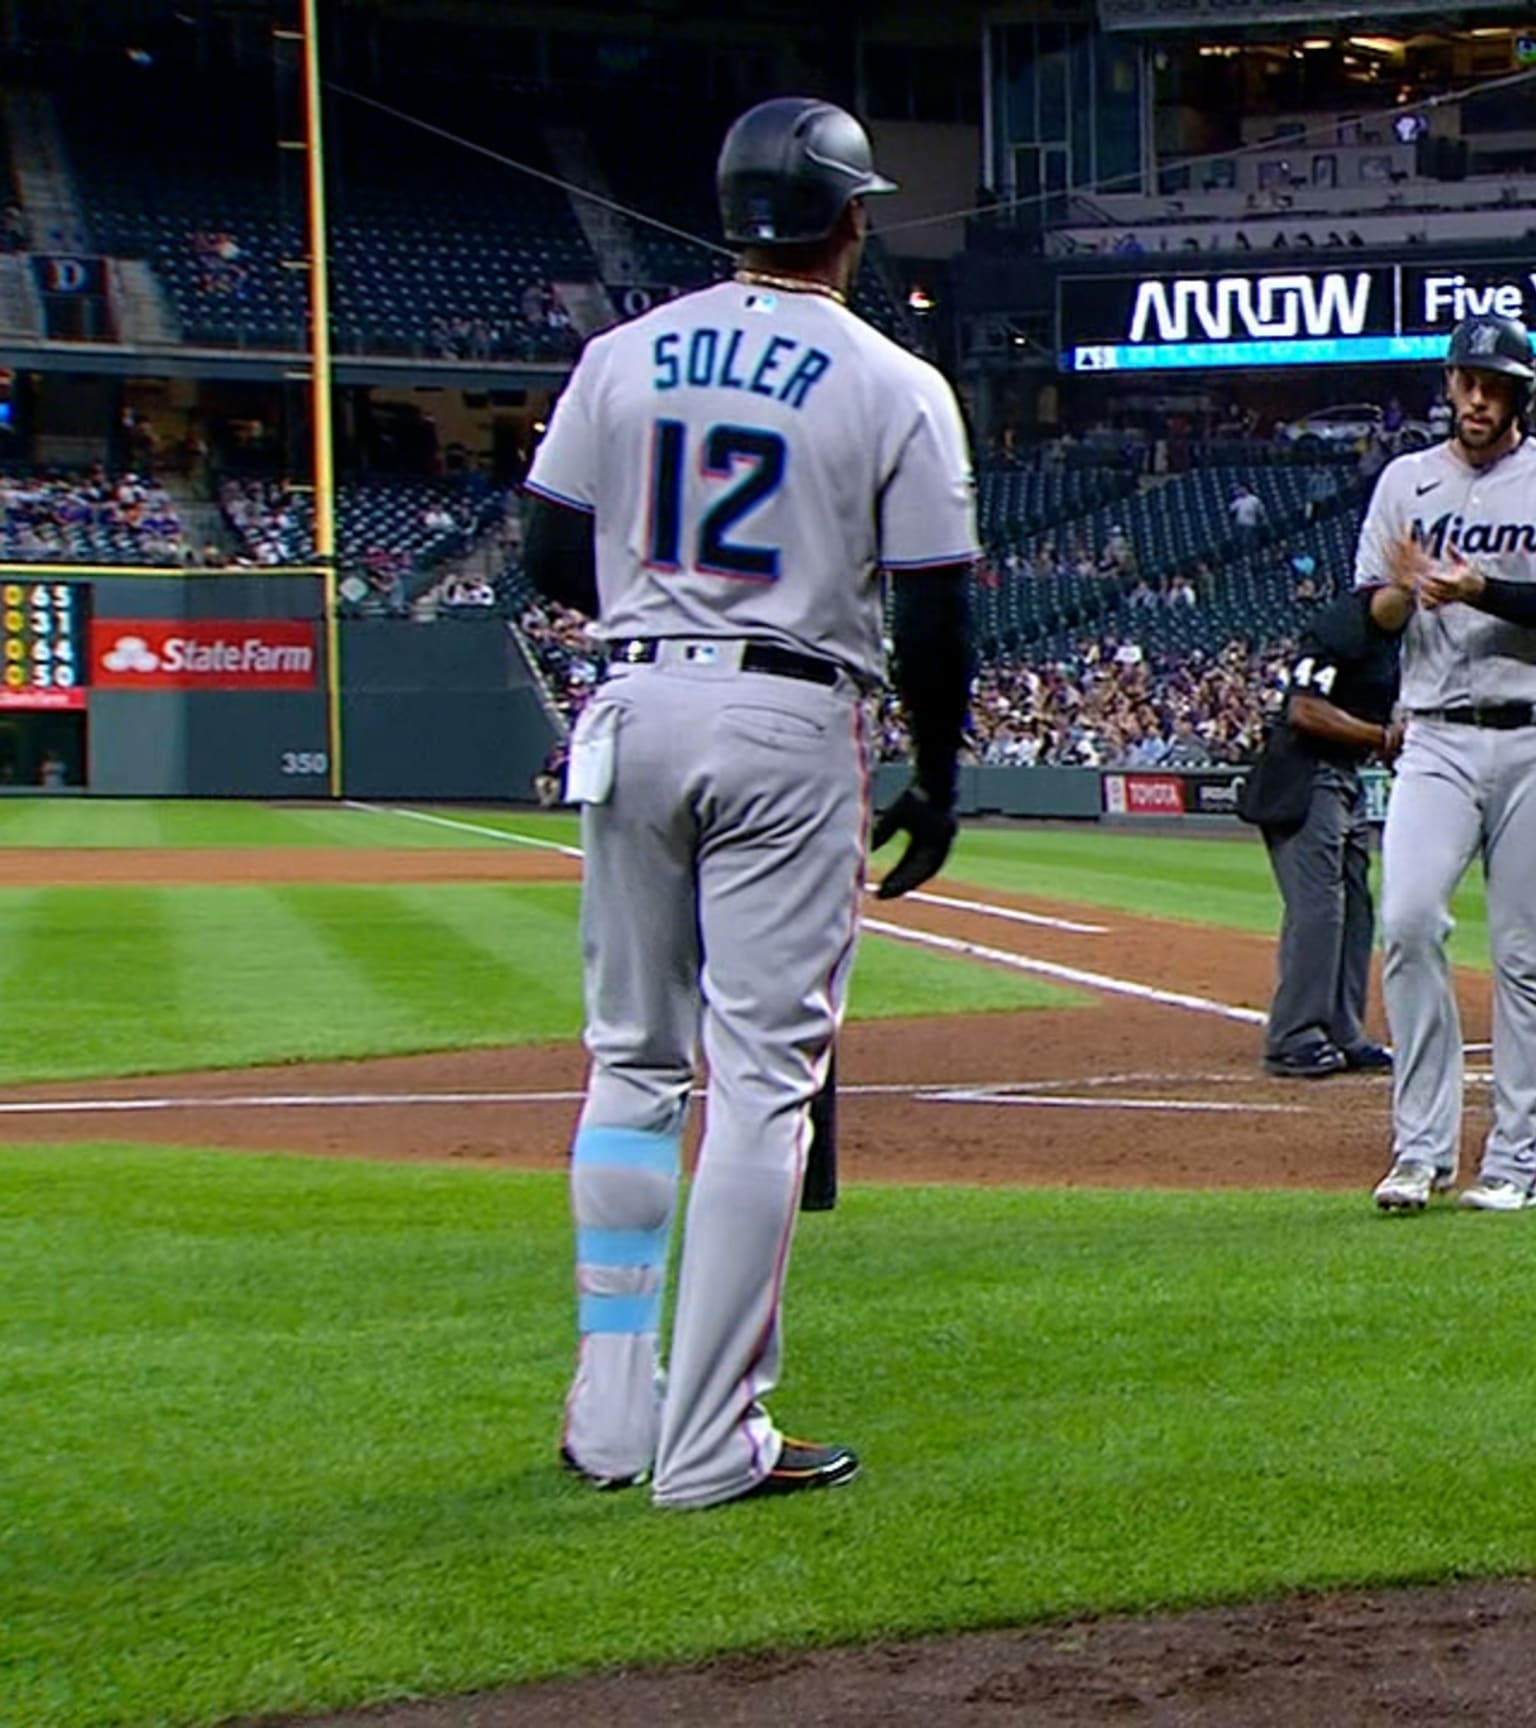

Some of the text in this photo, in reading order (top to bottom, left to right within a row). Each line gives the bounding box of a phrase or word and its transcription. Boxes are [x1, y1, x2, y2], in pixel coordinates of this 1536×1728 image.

[1129, 272, 1371, 342] ARROW
[1424, 275, 1523, 321] Five
[653, 327, 832, 409] SOLER
[641, 418, 788, 585] 12
[282, 752, 327, 773] 350
[1128, 781, 1183, 808] TOYOTA
